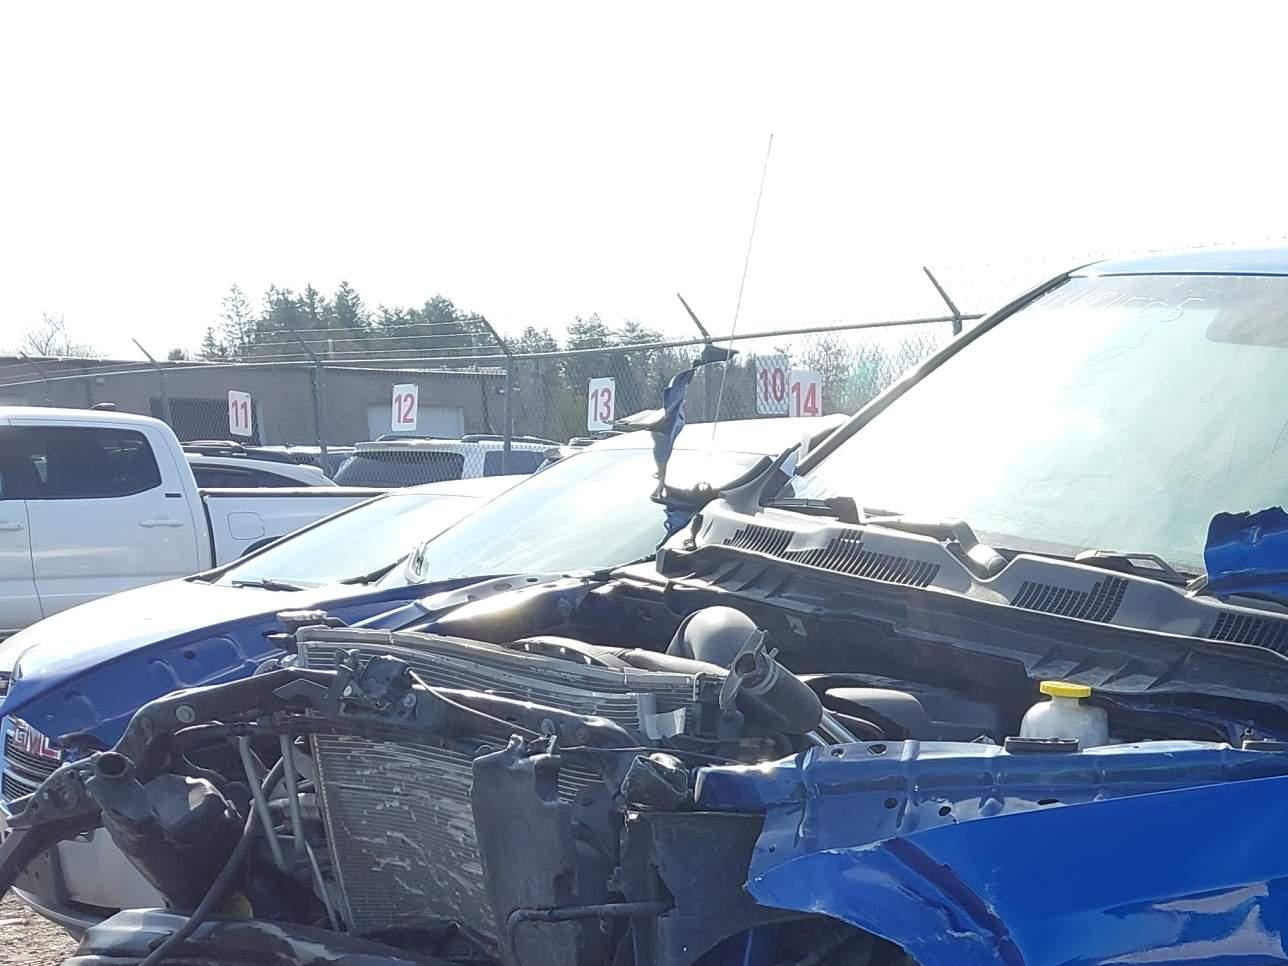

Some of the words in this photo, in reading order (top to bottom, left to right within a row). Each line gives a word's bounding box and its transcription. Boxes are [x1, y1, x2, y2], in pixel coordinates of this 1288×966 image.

[760, 367, 786, 402] 10
[791, 381, 819, 417] 14
[231, 399, 249, 429] 11
[394, 393, 415, 424] 12
[590, 387, 612, 424] 13
